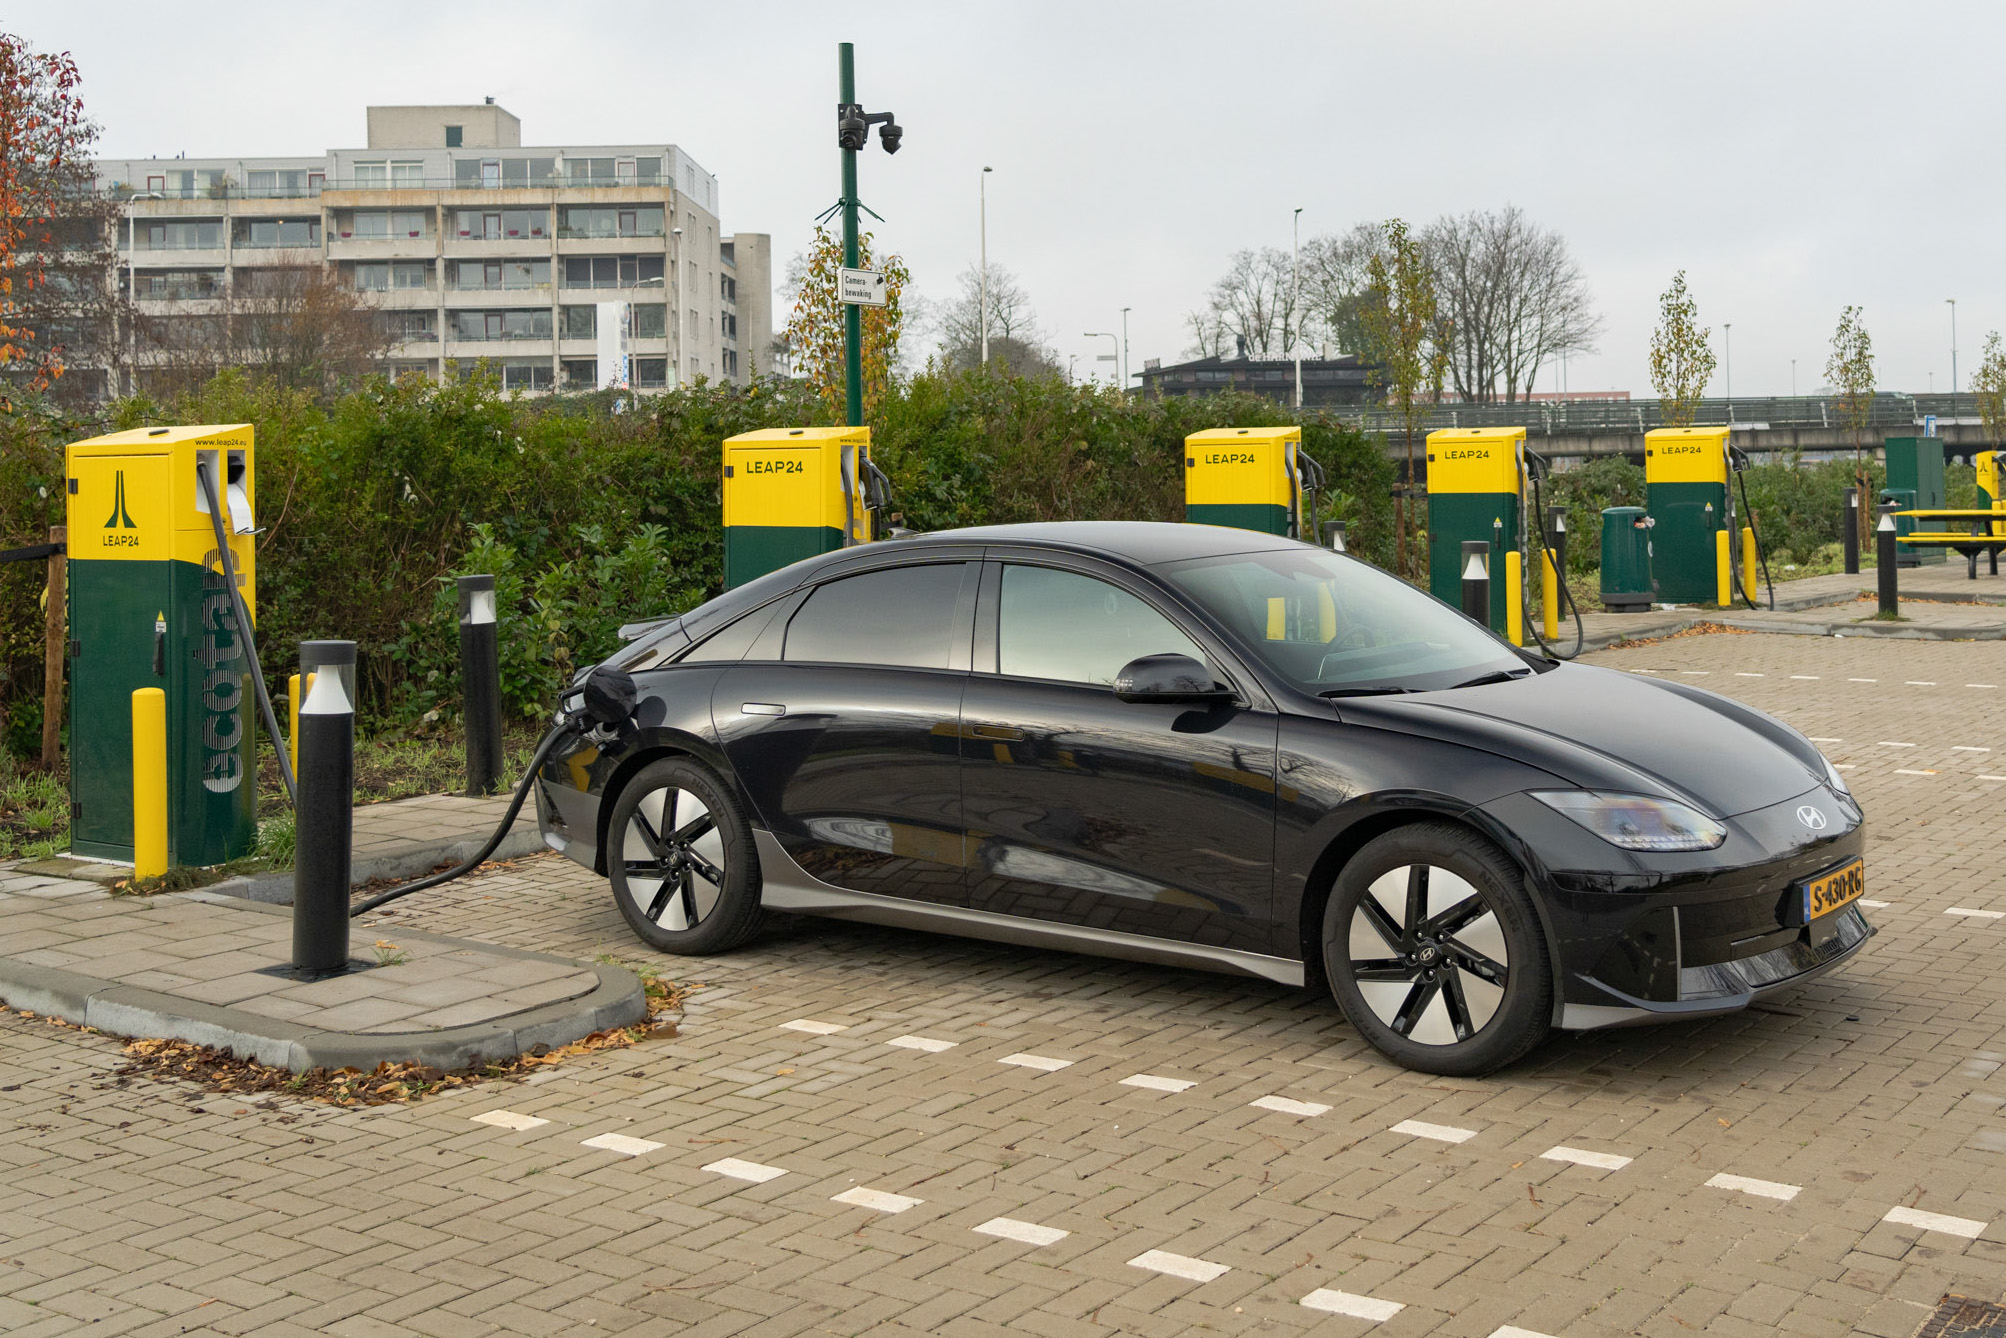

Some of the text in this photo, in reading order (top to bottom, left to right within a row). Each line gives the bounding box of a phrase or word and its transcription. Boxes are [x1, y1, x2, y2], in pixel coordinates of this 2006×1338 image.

[845, 275, 867, 285] Camera-
[845, 288, 872, 300] bewaking
[1262, 352, 1322, 361] HARMNIE
[195, 438, 246, 447] www.leap24.eu
[1445, 450, 1490, 459] LEAP24
[1662, 446, 1702, 454] LEAP24
[1205, 454, 1255, 464] LEAP24
[746, 461, 803, 473] LEAP24
[103, 535, 139, 547] LEAP24
[193, 548, 246, 793] ecotap
[1814, 866, 1861, 912] S-430-RG
